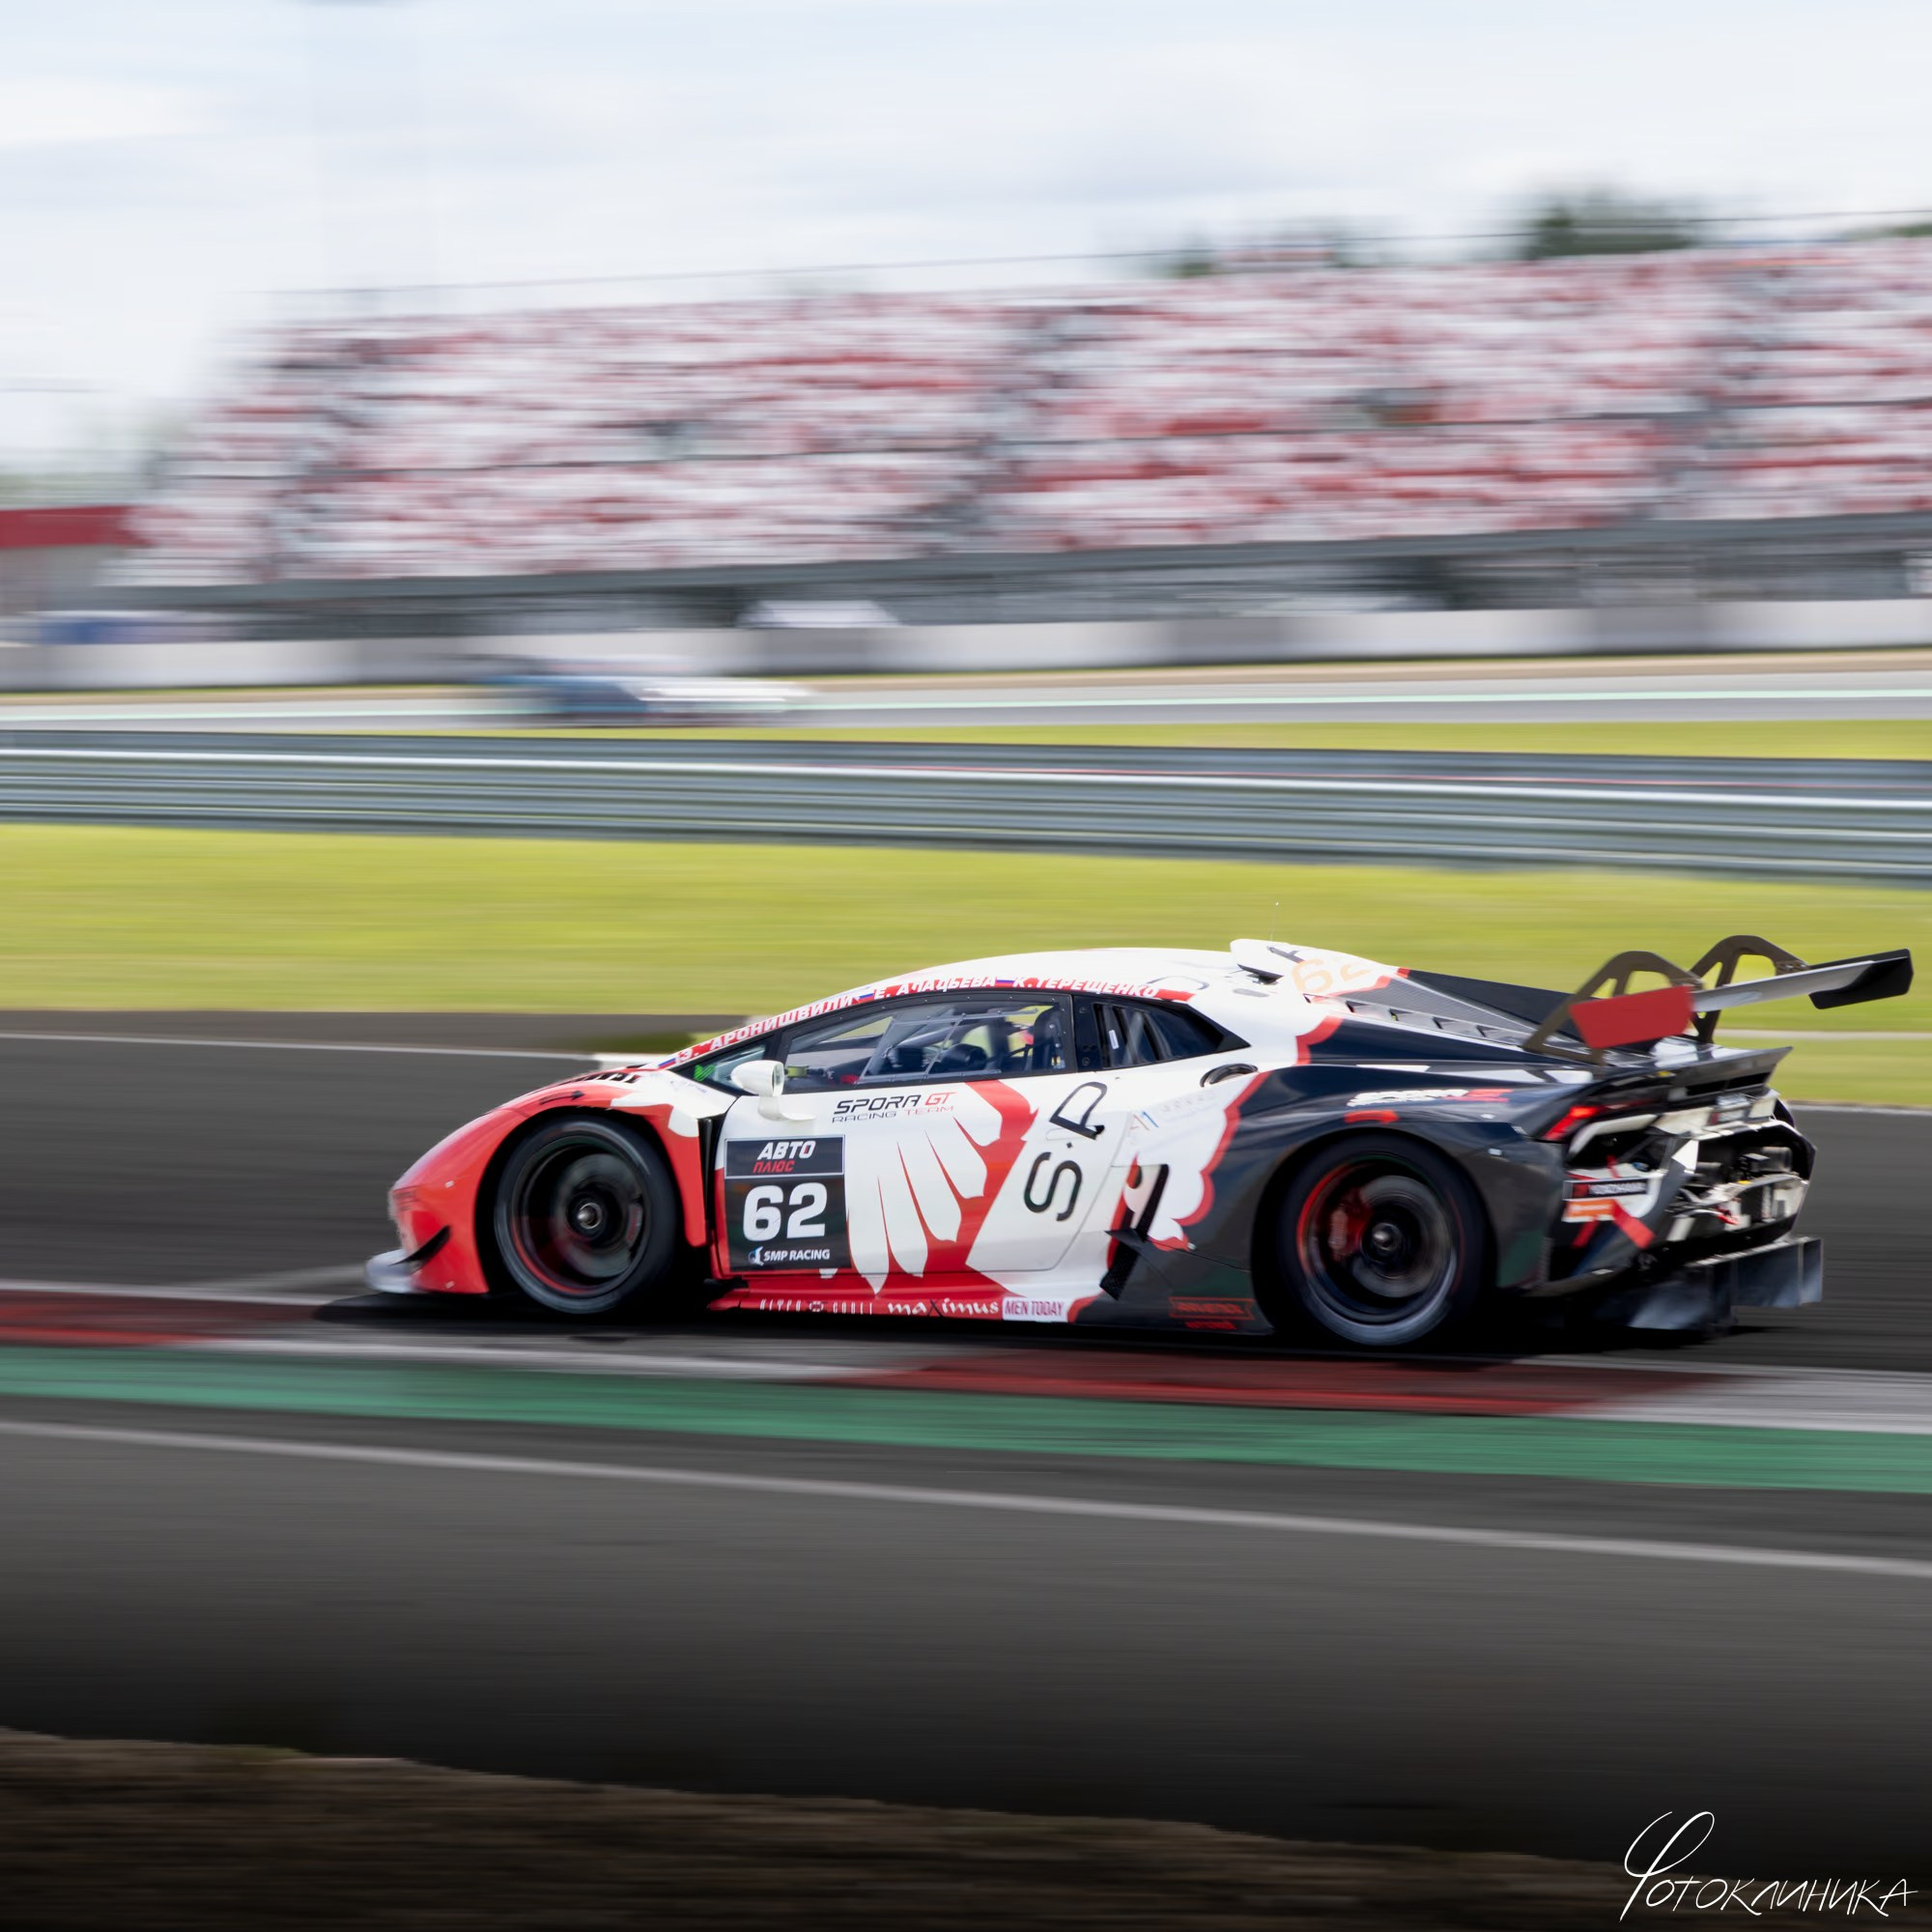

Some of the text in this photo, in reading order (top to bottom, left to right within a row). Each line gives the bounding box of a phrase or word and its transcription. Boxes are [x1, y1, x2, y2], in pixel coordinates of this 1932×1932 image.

[710, 995, 854, 1050] АРОНИШВИЛИ
[834, 1092, 957, 1115] SPORA GT
[832, 1105, 954, 1123] RACING TEAM
[756, 1140, 816, 1160] АВТО
[753, 1160, 796, 1174] ПЛЮС
[743, 1181, 828, 1242] 62
[763, 1248, 831, 1263] SMP RACING
[1005, 1300, 1065, 1317] MEN TODAY
